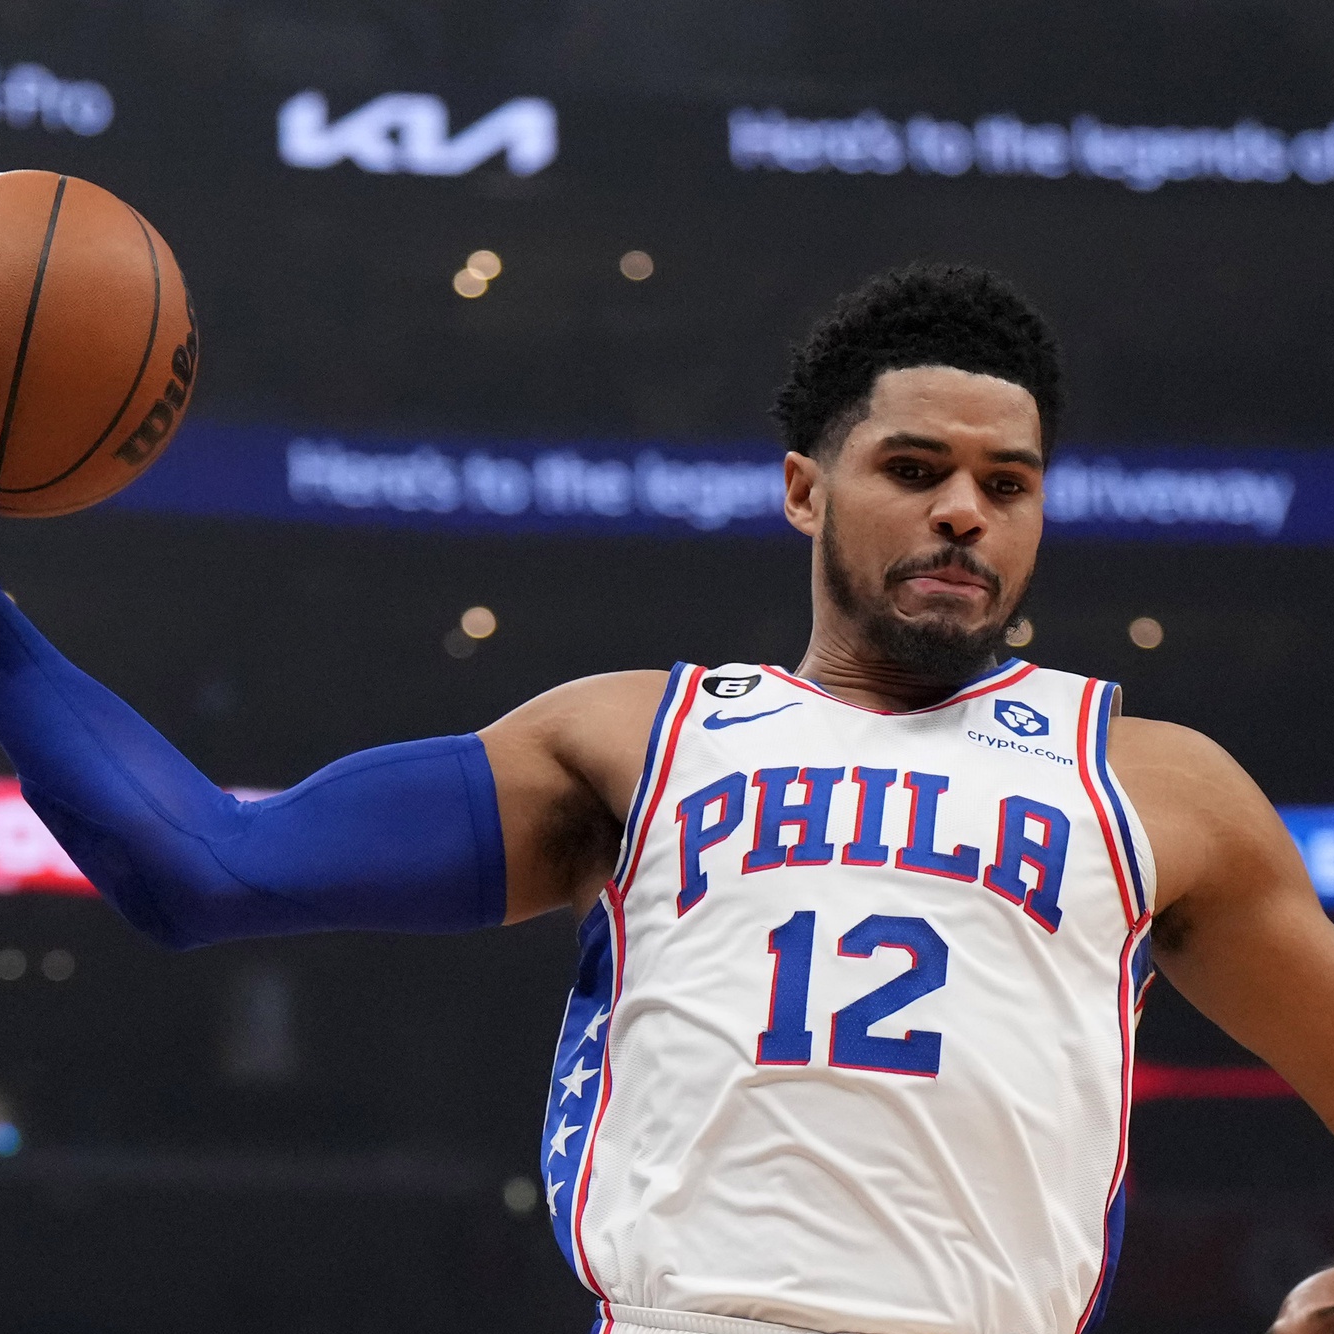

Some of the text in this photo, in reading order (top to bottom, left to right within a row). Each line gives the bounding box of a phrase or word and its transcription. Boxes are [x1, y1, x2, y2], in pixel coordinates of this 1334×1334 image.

[728, 107, 906, 175] Here's
[906, 112, 973, 177] to
[974, 112, 1069, 179] the
[1069, 112, 1292, 192] legends
[286, 437, 461, 514] Here's
[464, 449, 531, 515] to
[533, 450, 633, 517] the
[715, 679, 751, 697] 6
[967, 729, 1074, 766] crypto.com
[674, 765, 1071, 935] PHILA
[755, 910, 949, 1079] 12
